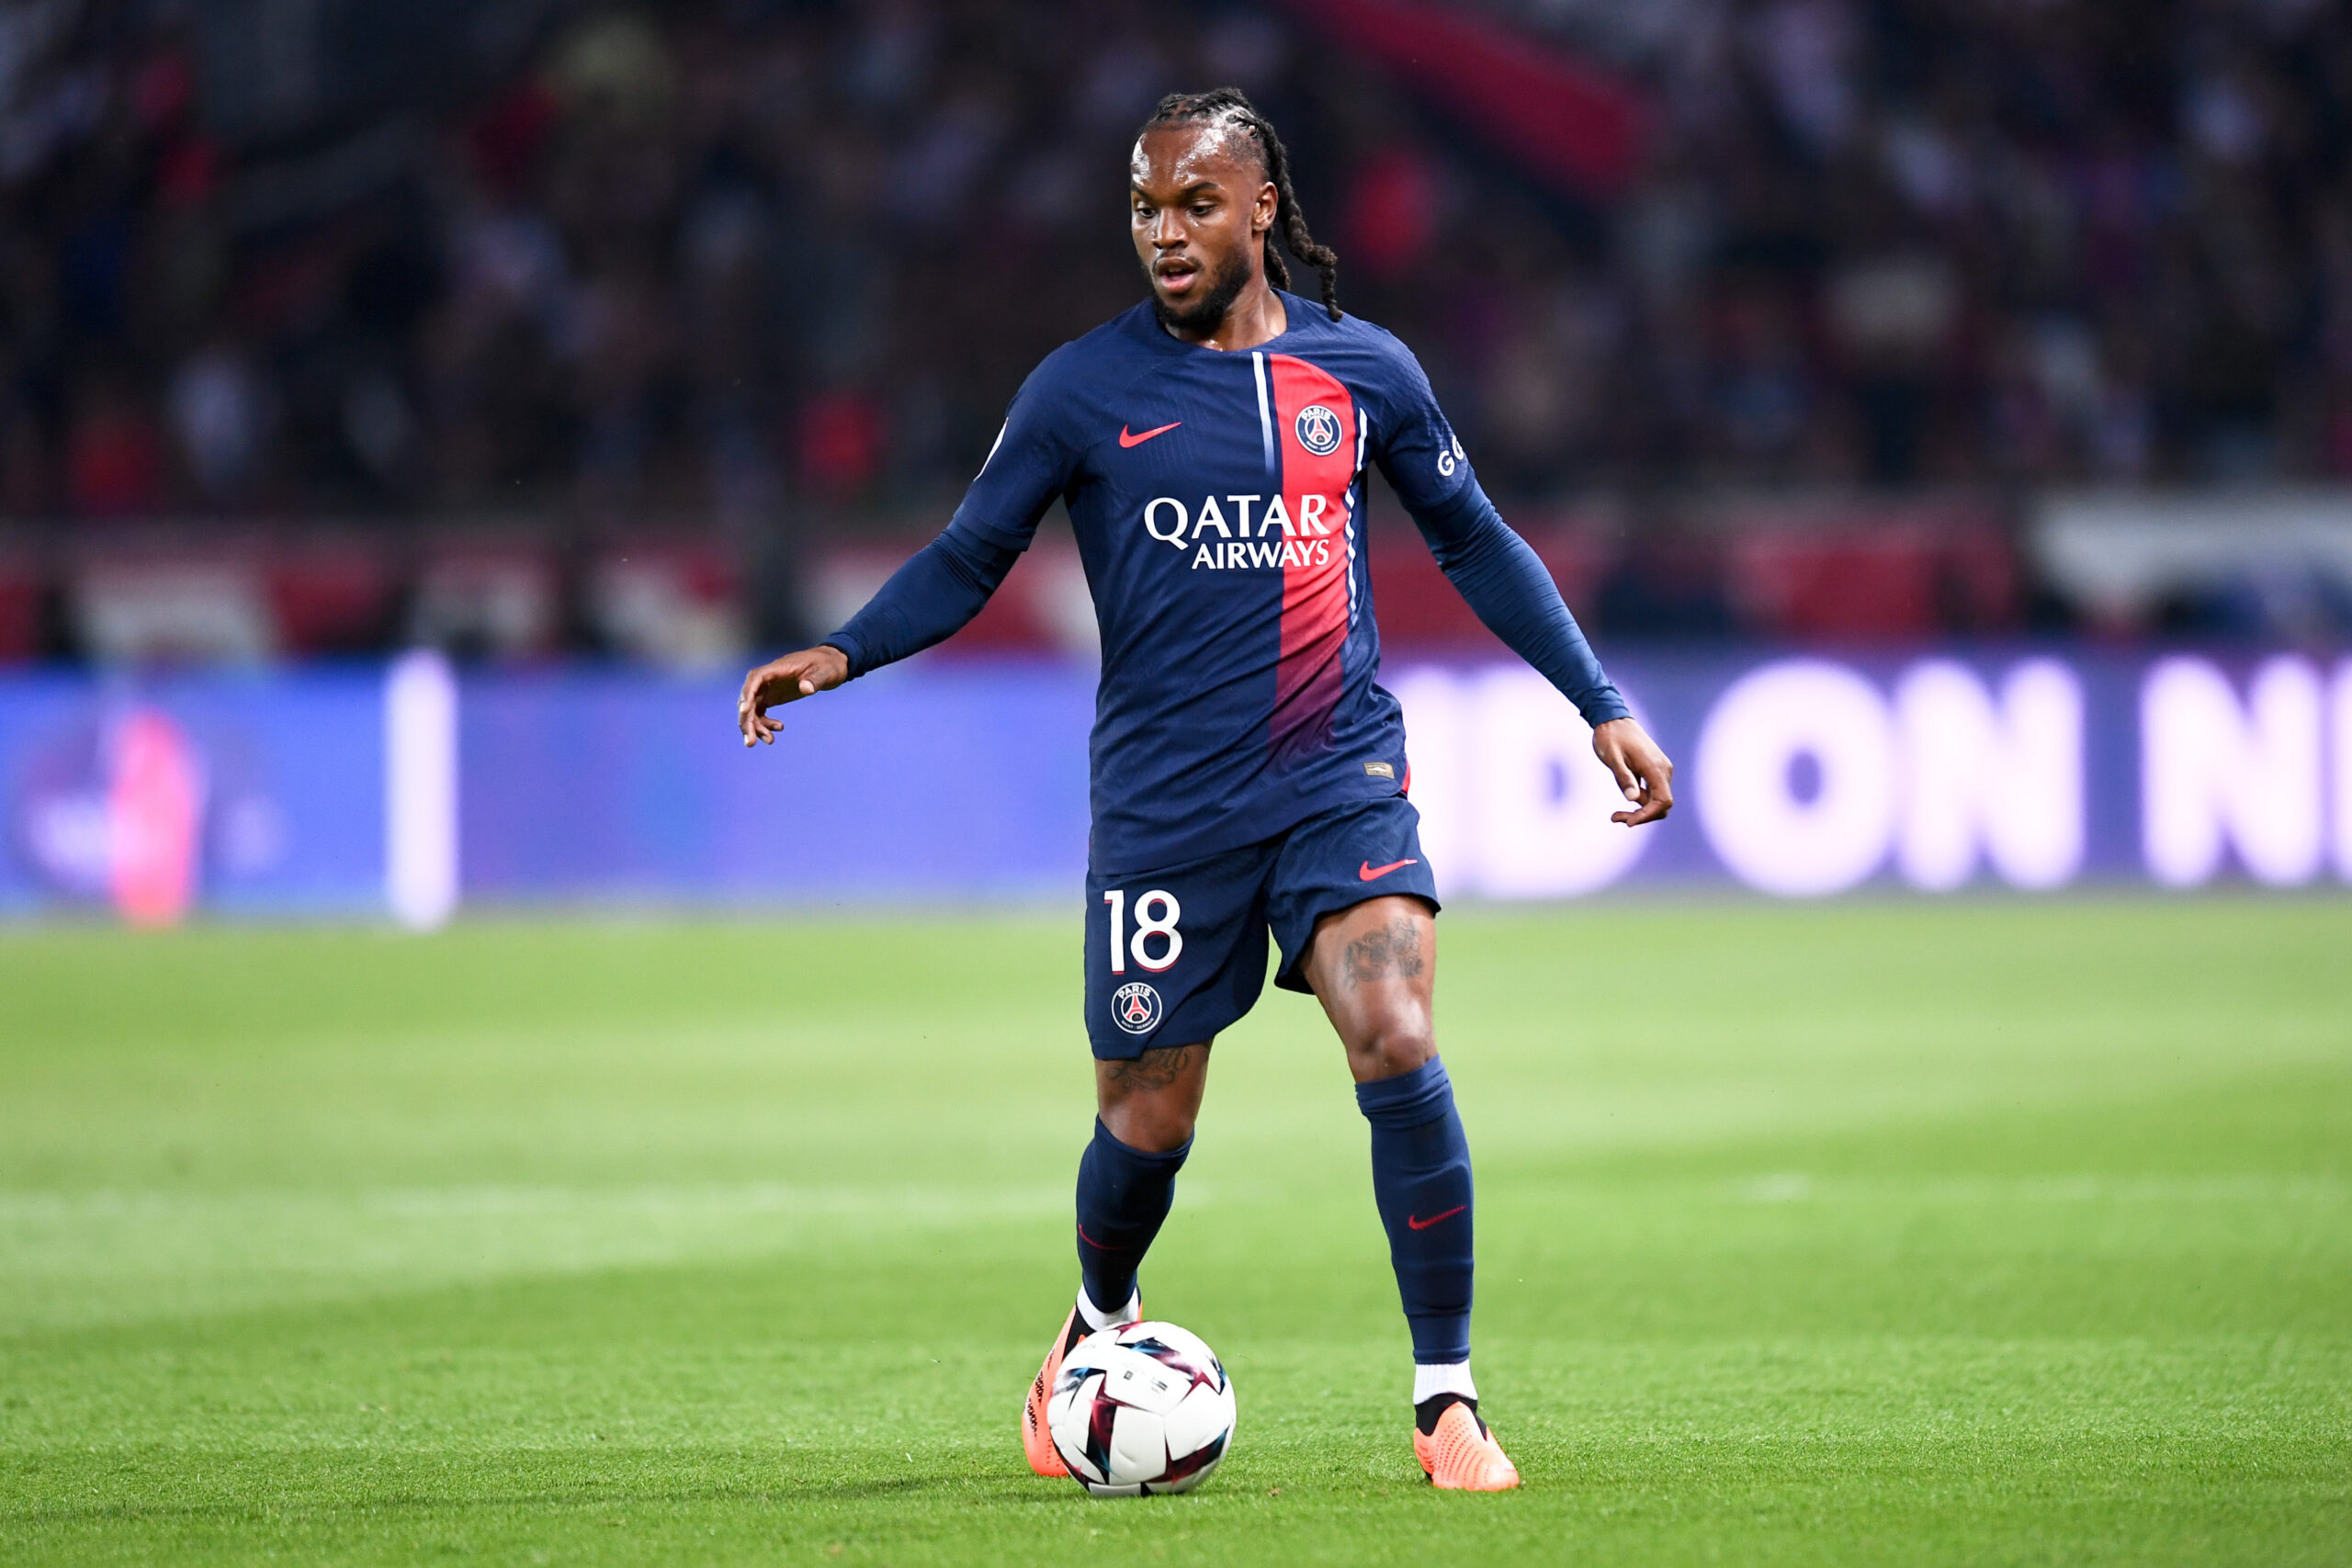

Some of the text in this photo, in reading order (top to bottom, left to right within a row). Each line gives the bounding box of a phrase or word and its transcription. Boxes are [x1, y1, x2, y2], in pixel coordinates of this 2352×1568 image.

[1300, 408, 1331, 421] PARIS
[1144, 493, 1331, 551] QATAR
[1192, 538, 1330, 570] AIRWAYS
[1695, 656, 2084, 895] ON
[2139, 654, 2352, 887] N
[1103, 889, 1183, 976] 18
[1117, 985, 1152, 999] PARIS
